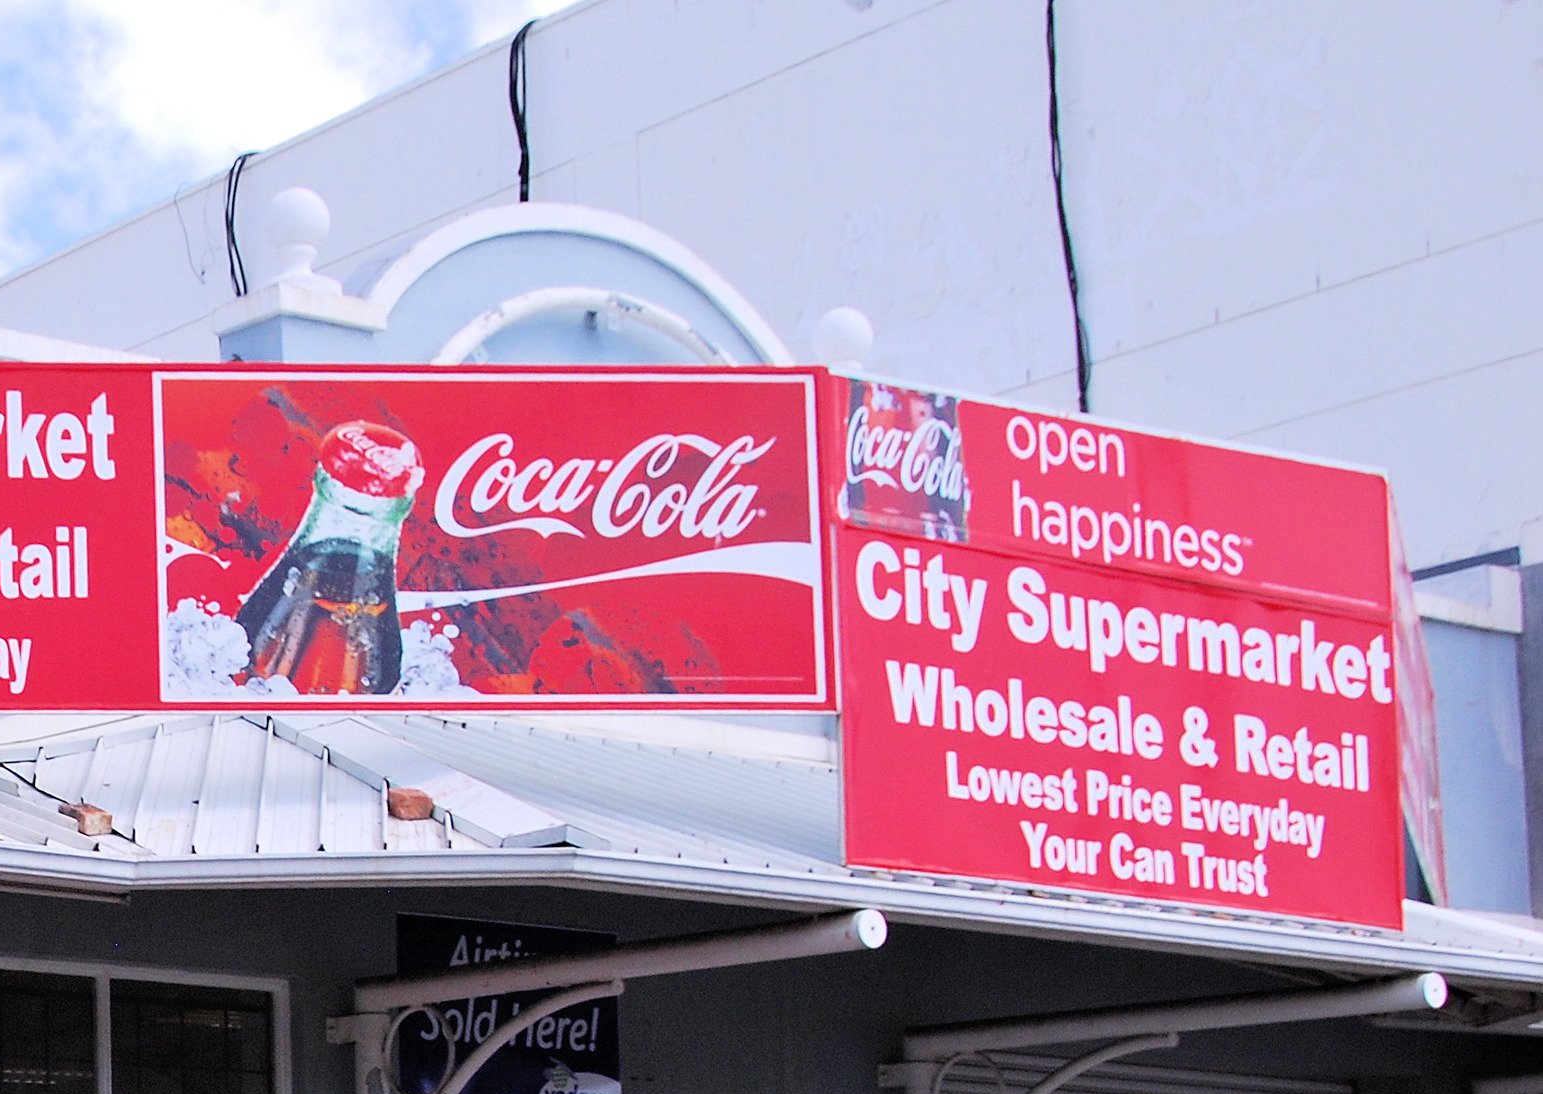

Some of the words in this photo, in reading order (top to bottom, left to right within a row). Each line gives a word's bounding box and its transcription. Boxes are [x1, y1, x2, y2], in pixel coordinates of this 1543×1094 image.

[434, 432, 776, 540] Coca-Cola
[845, 407, 964, 500] Coca-Cola
[1006, 414, 1126, 478] open
[1013, 481, 1245, 577] happiness
[856, 541, 987, 653] City
[1007, 567, 1394, 704] Supermarket
[886, 660, 1164, 760] Wholesale
[1180, 706, 1218, 769] &
[1235, 714, 1370, 792] Retail
[945, 751, 1077, 813] Lowest
[1086, 769, 1173, 827] Price
[1182, 785, 1325, 858] Everyday
[1020, 821, 1102, 875] Your
[1109, 839, 1175, 886] Can
[1181, 843, 1268, 897] Trust
